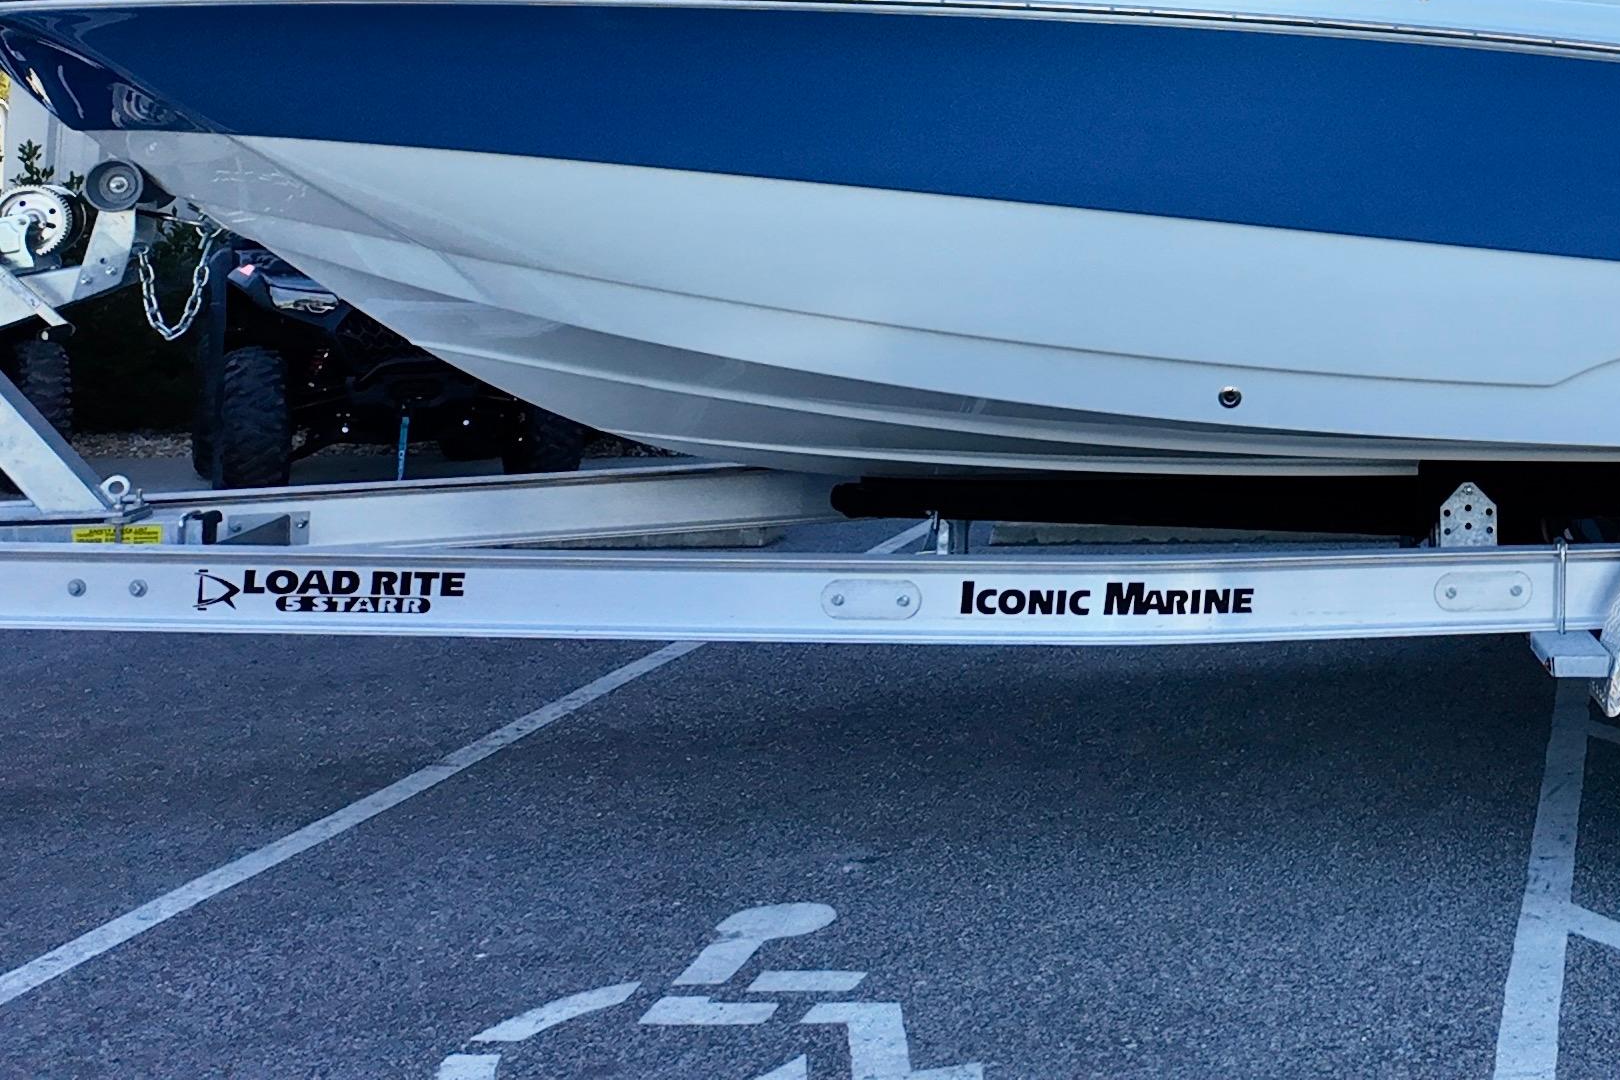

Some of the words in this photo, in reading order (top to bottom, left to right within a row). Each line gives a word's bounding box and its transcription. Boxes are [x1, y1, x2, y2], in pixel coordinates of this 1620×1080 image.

[243, 569, 360, 595] LOAD
[371, 571, 465, 596] RITE
[284, 597, 302, 610] 5
[311, 597, 422, 613] STARR
[961, 581, 1091, 615] ICONIC
[1104, 582, 1254, 615] MARINE
